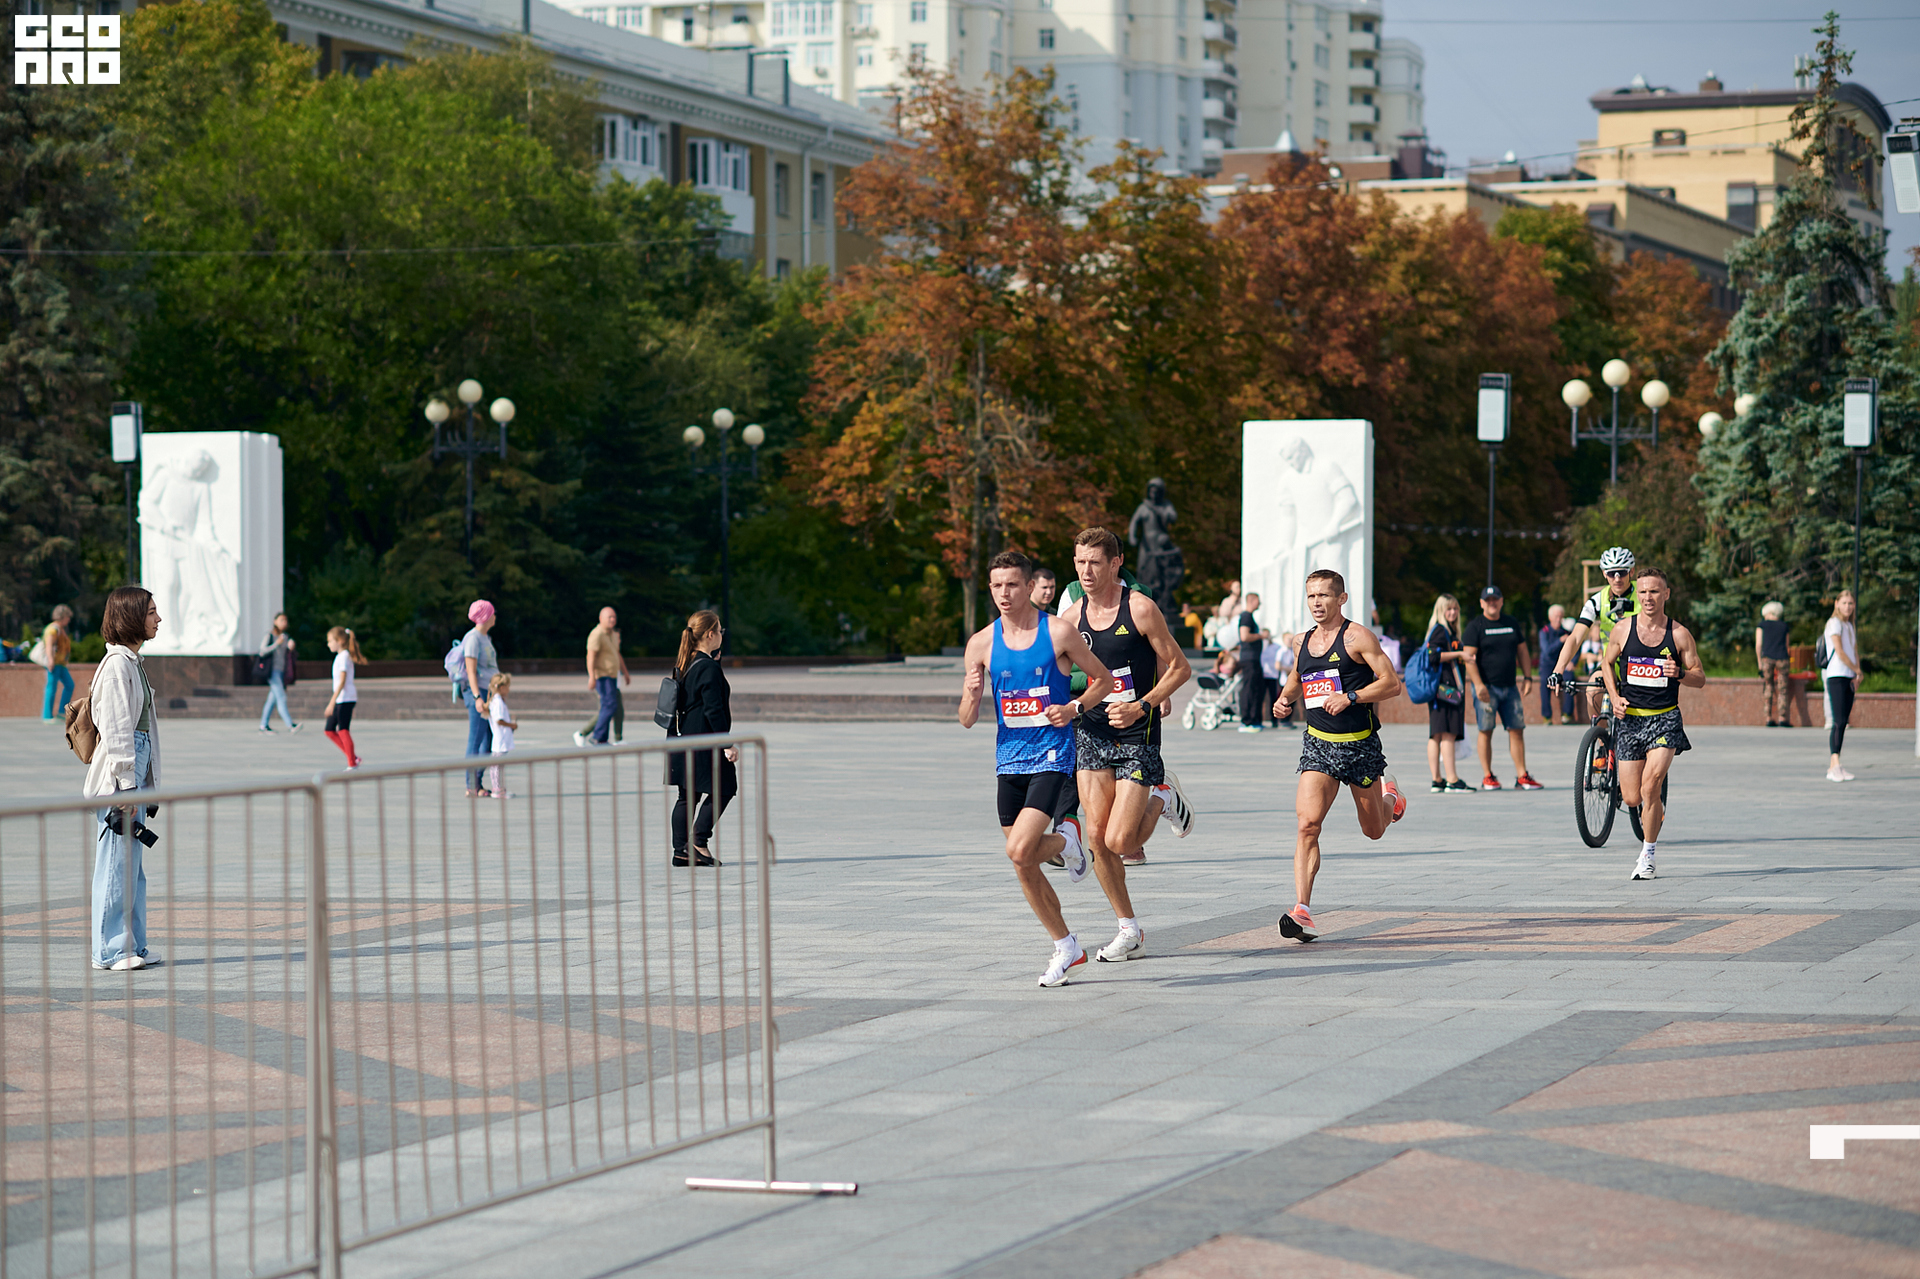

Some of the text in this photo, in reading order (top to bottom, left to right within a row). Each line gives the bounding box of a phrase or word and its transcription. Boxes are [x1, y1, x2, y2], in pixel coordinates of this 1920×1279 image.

[1630, 665, 1661, 677] 2000
[1306, 681, 1331, 696] 2326
[1005, 701, 1038, 714] 2324
